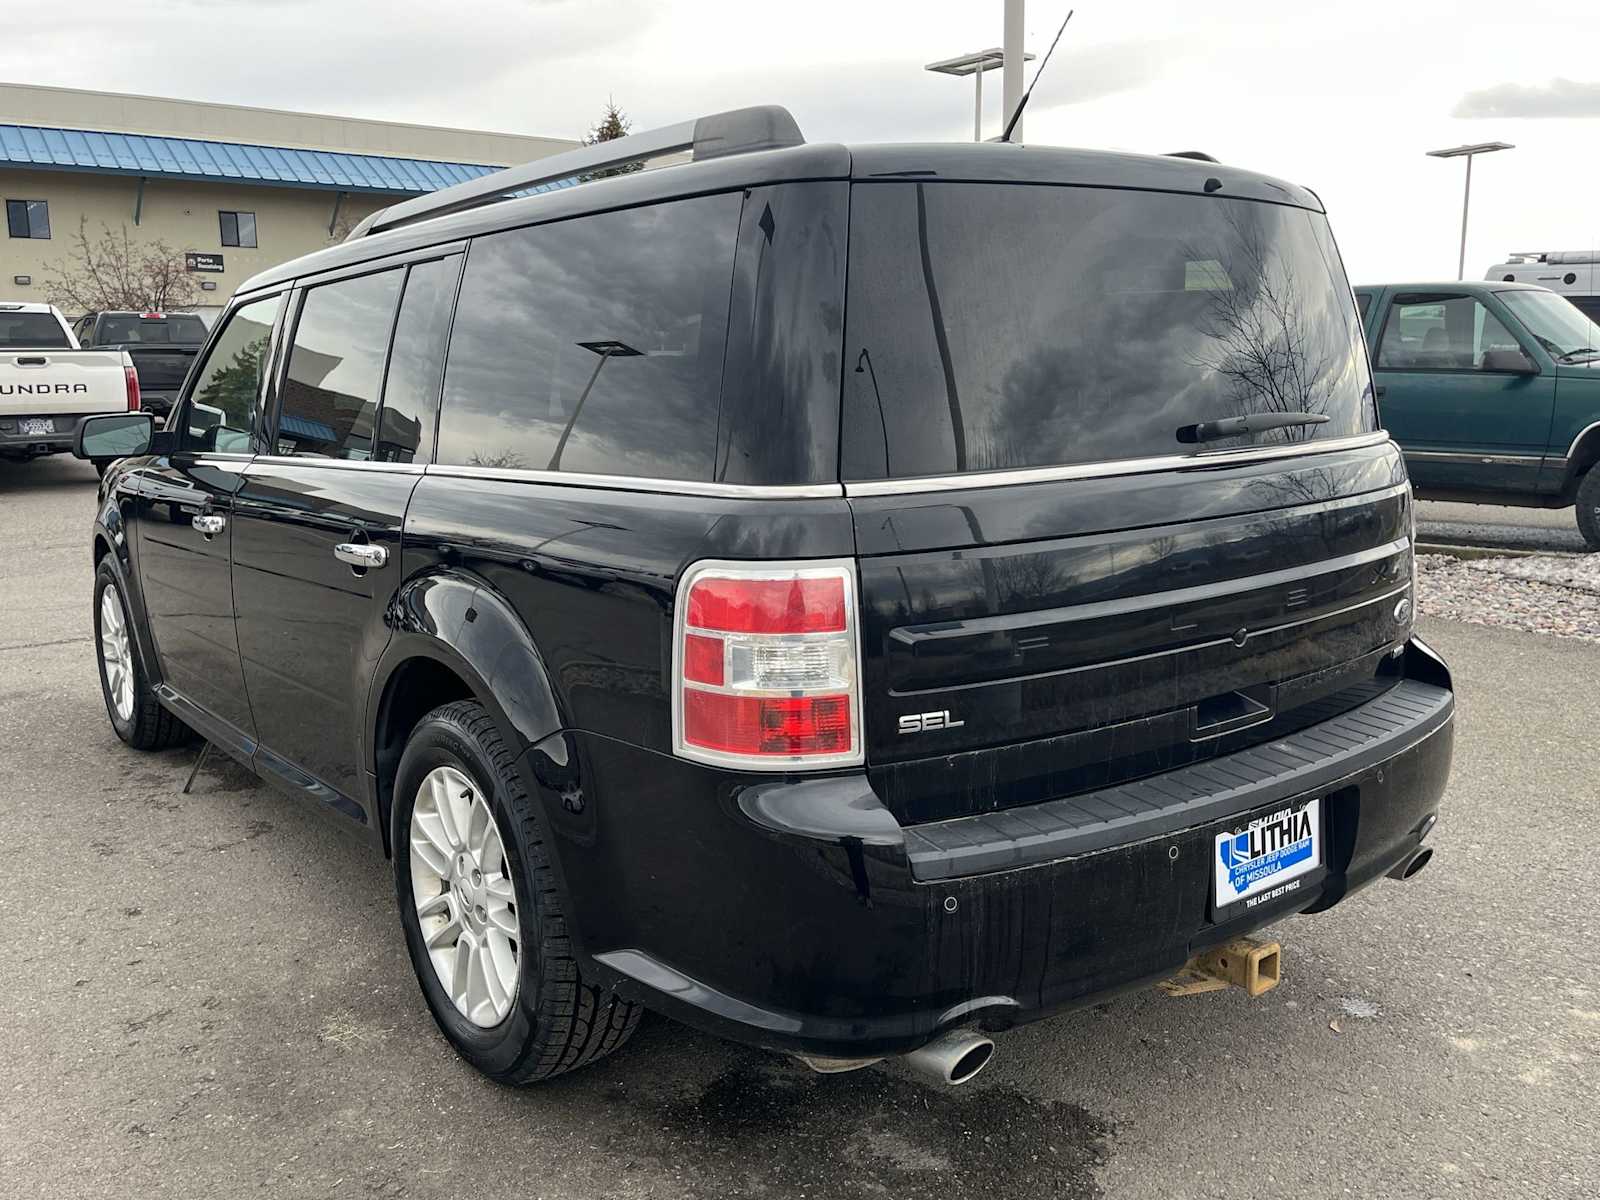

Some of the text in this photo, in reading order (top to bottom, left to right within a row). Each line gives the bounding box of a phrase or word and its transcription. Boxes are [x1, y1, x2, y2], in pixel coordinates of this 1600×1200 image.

[898, 709, 965, 734] SEL
[1250, 811, 1312, 859] LITHIA
[1234, 859, 1265, 875] CHRYSLER
[1265, 853, 1280, 864] JEEP
[1235, 861, 1282, 888] OF MISSOULA
[1246, 880, 1300, 908] THE LAST BEST PRICE
